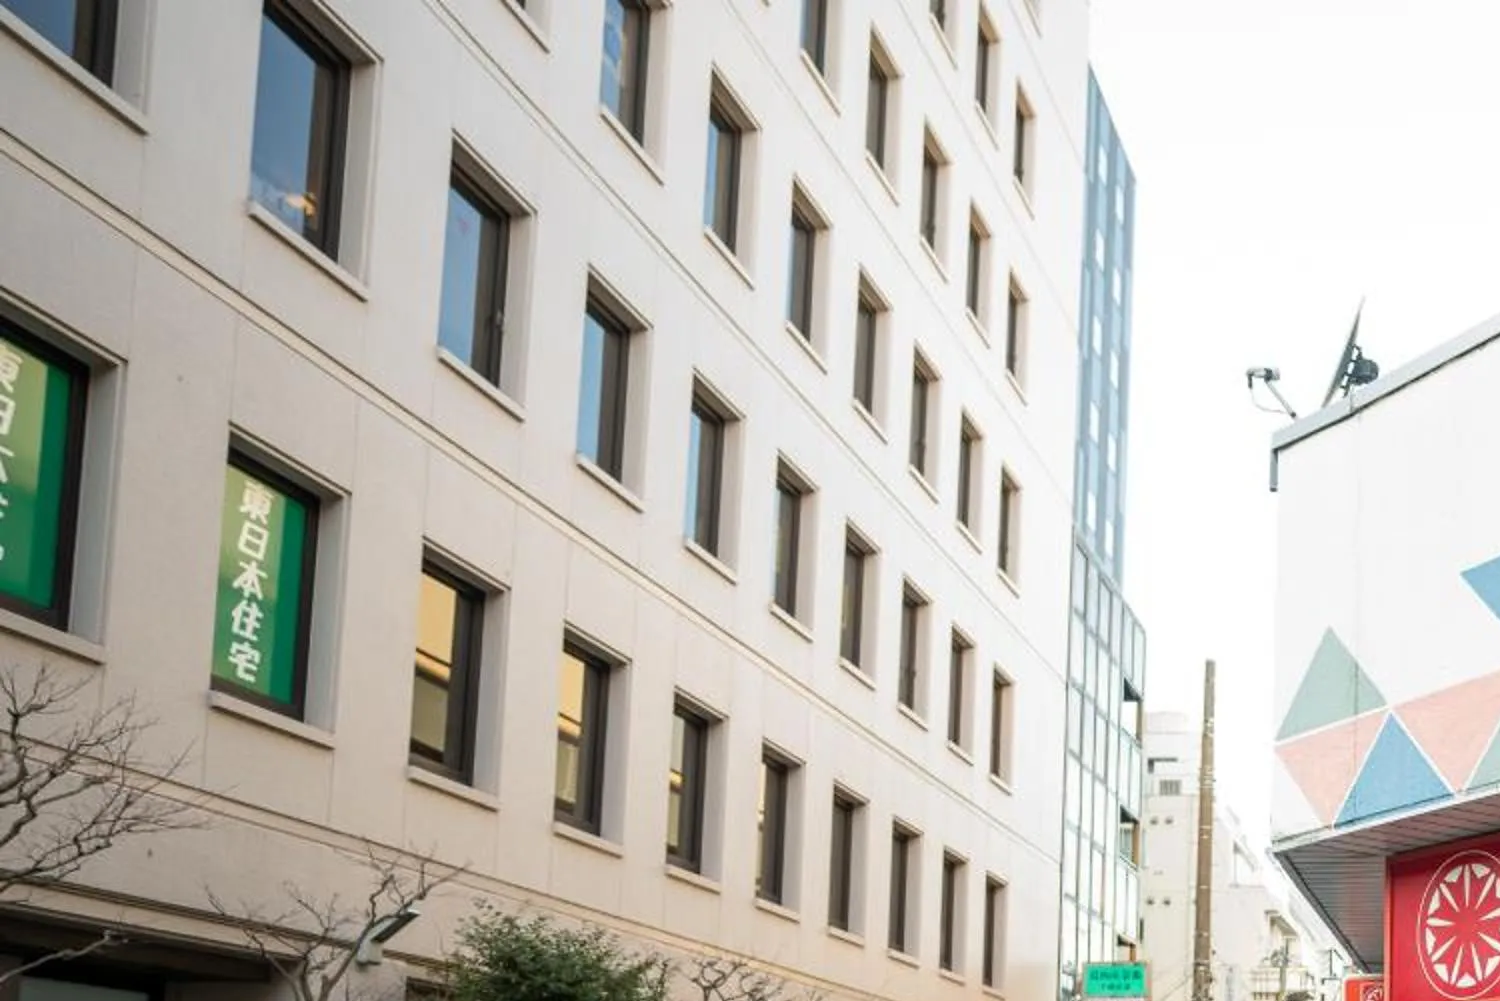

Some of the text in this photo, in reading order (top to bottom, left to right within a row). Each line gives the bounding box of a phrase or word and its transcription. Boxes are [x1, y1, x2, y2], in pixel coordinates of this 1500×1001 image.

[228, 480, 273, 683] 東日本住宅
